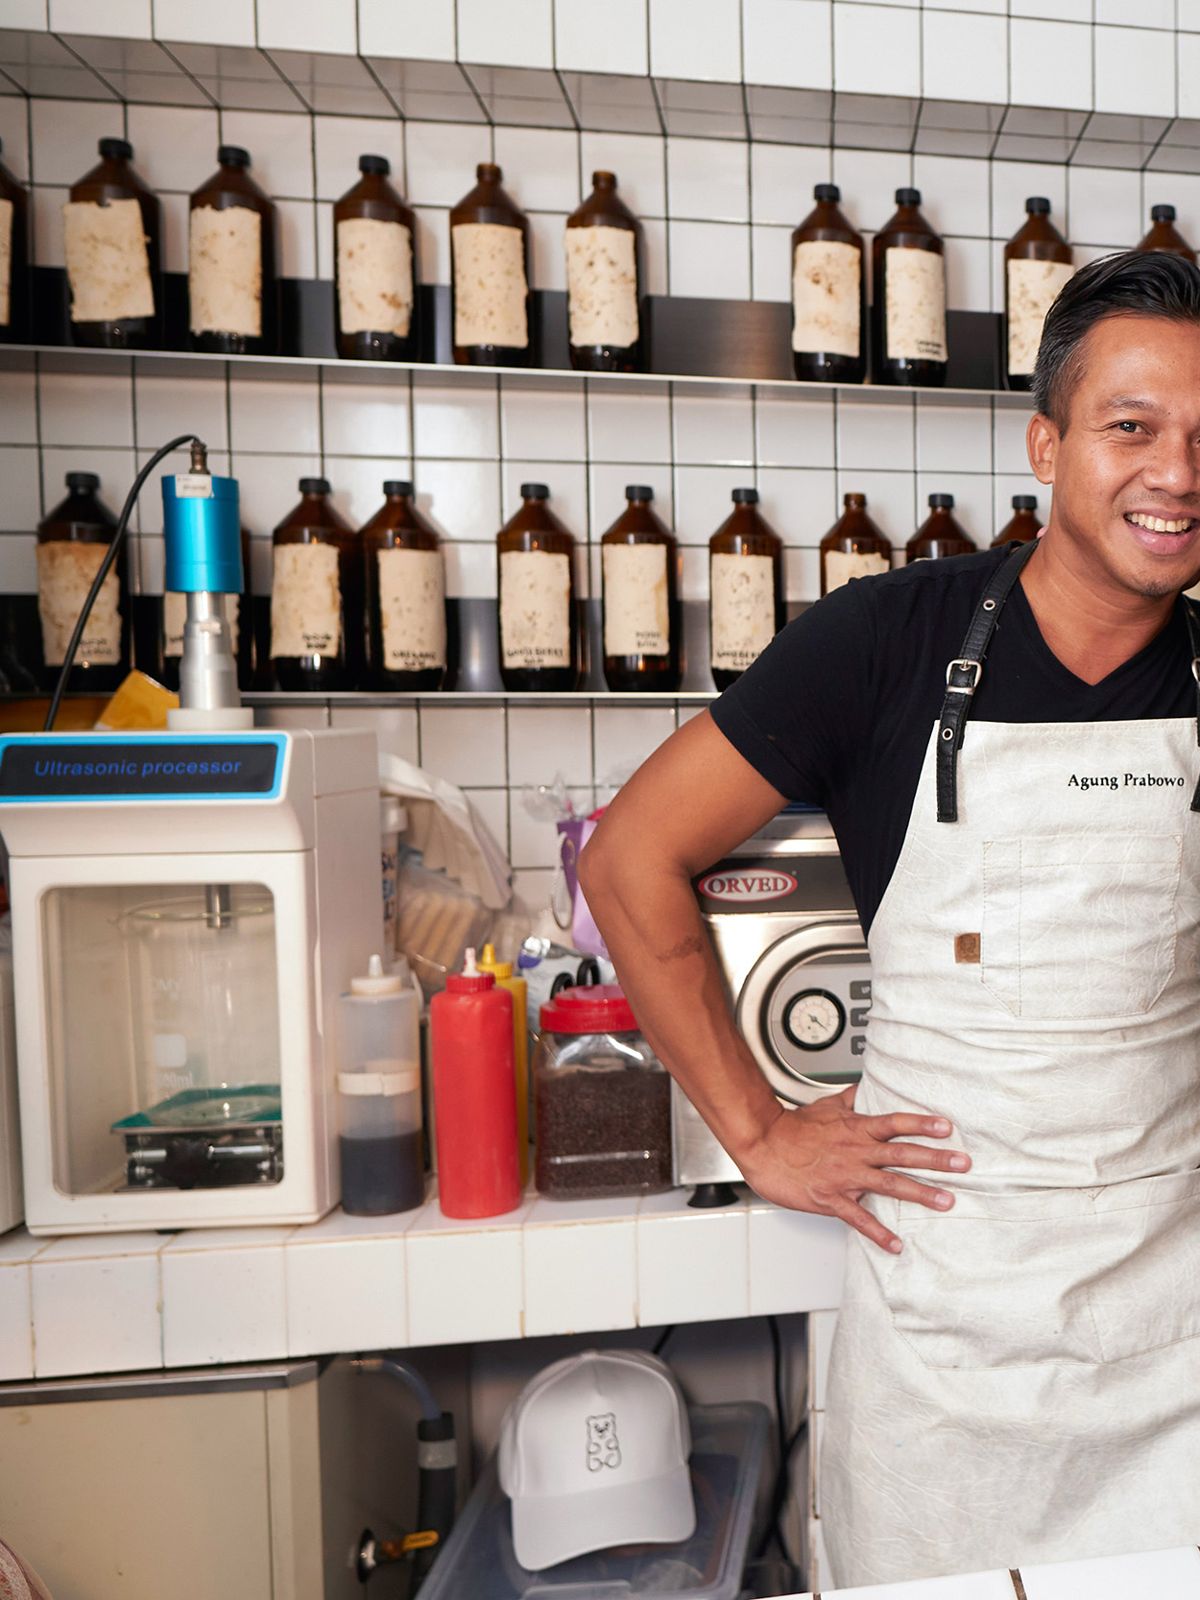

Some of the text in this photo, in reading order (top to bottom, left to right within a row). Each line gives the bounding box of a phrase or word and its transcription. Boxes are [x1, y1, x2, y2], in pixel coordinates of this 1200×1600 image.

[34, 760, 242, 778] Ultrasonic processor
[1068, 772, 1185, 791] Agung Prabowo
[708, 877, 788, 894] ORVED
